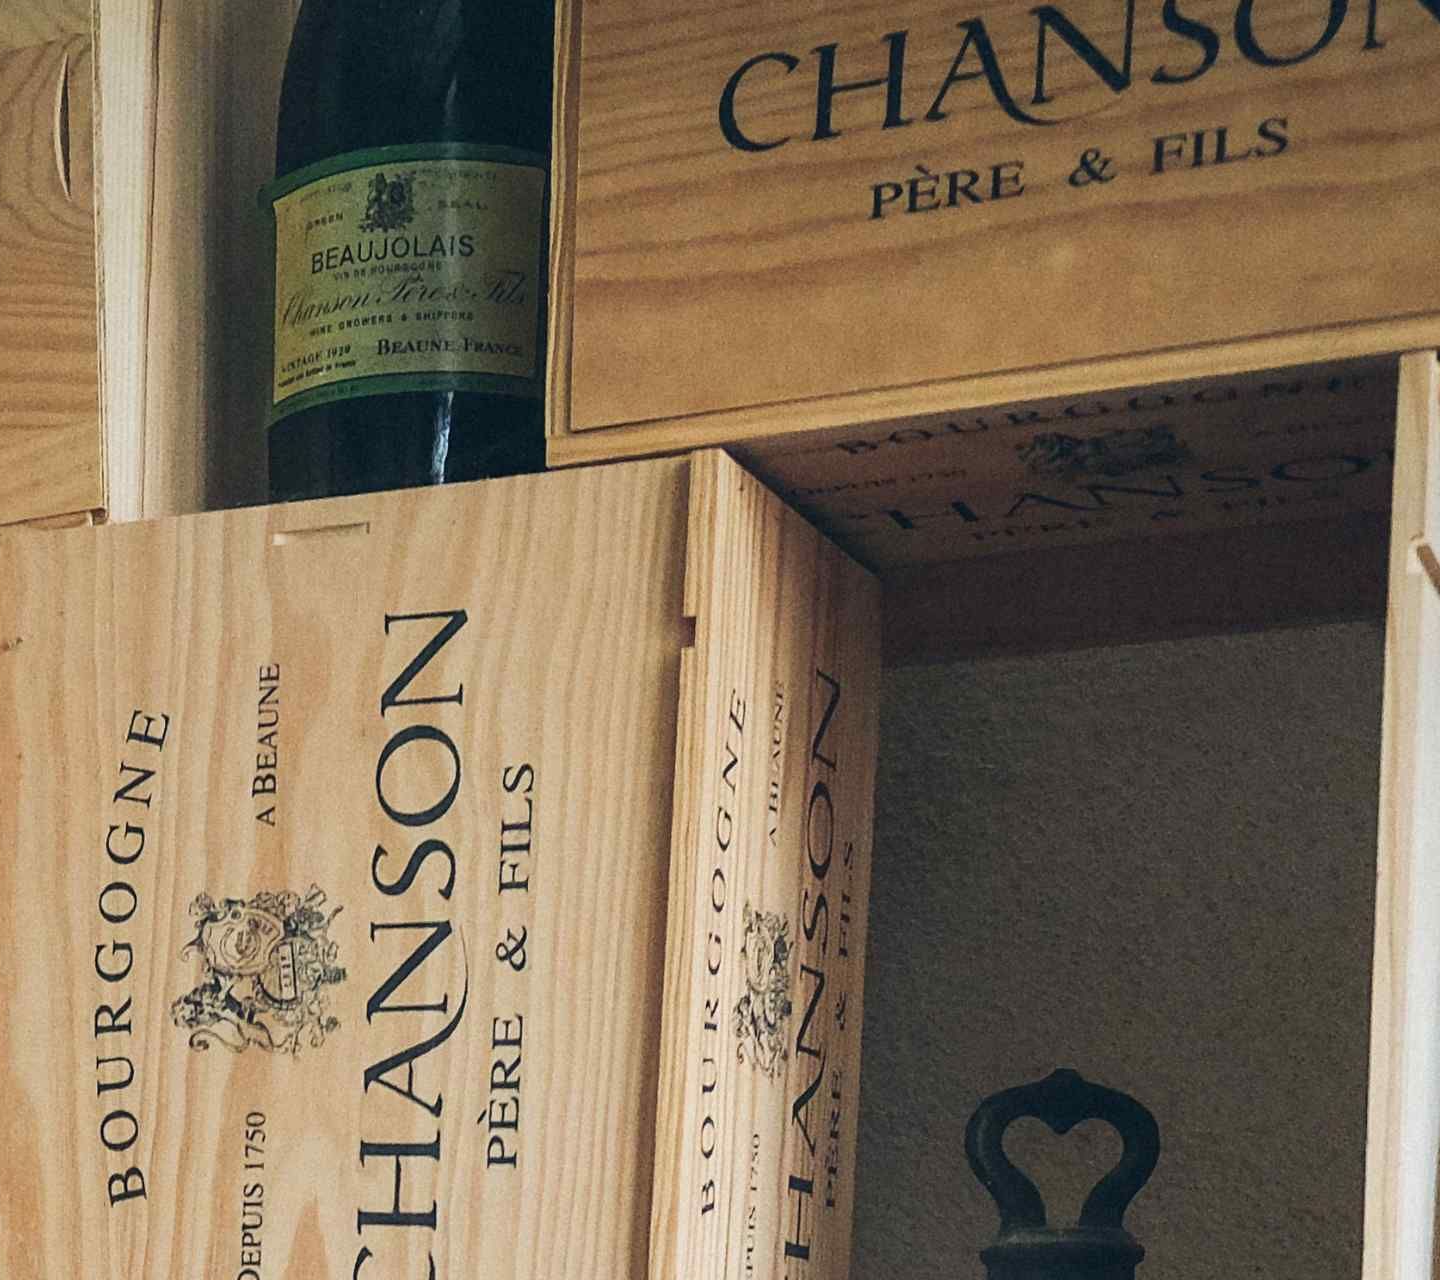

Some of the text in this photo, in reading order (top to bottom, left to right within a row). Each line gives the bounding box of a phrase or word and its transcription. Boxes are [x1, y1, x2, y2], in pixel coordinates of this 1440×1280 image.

[869, 116, 1289, 220] PÈRE & FILS
[310, 234, 475, 275] BEAUJOLAIS
[377, 338, 452, 366] BEAUNE
[250, 660, 282, 828] A BEAUNE
[92, 706, 171, 1208] BOURGOGNE
[476, 760, 536, 1171] PÈRE & FILS
[700, 687, 748, 1218] BOURGOGNE
[240, 1108, 267, 1168] 1750
